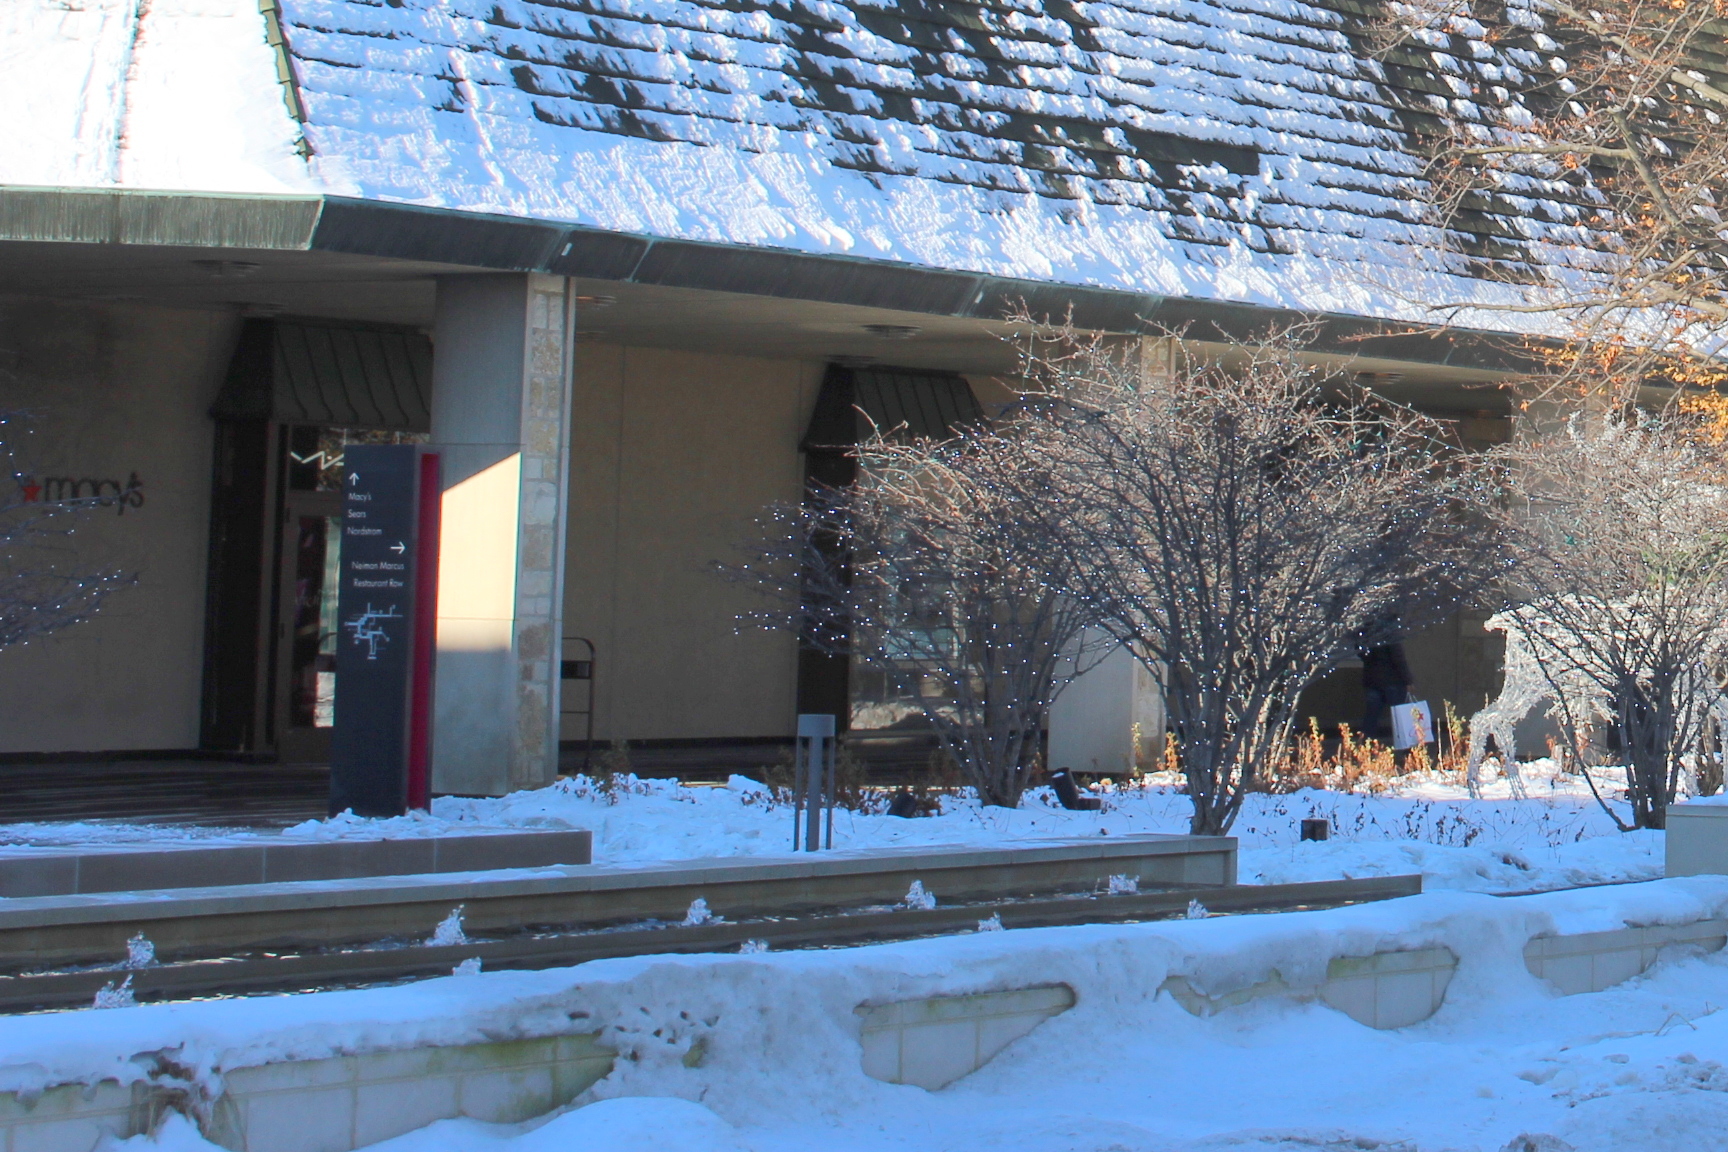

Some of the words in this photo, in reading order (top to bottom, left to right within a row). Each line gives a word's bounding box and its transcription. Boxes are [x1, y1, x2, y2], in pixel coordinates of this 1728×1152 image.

[348, 493, 372, 502] Macy's
[348, 509, 366, 518] Sears
[347, 526, 382, 535] Nordstrom
[352, 561, 378, 570] Neiman
[380, 561, 405, 570] Marcus
[353, 578, 388, 587] Restaurant
[389, 578, 403, 587] Row
